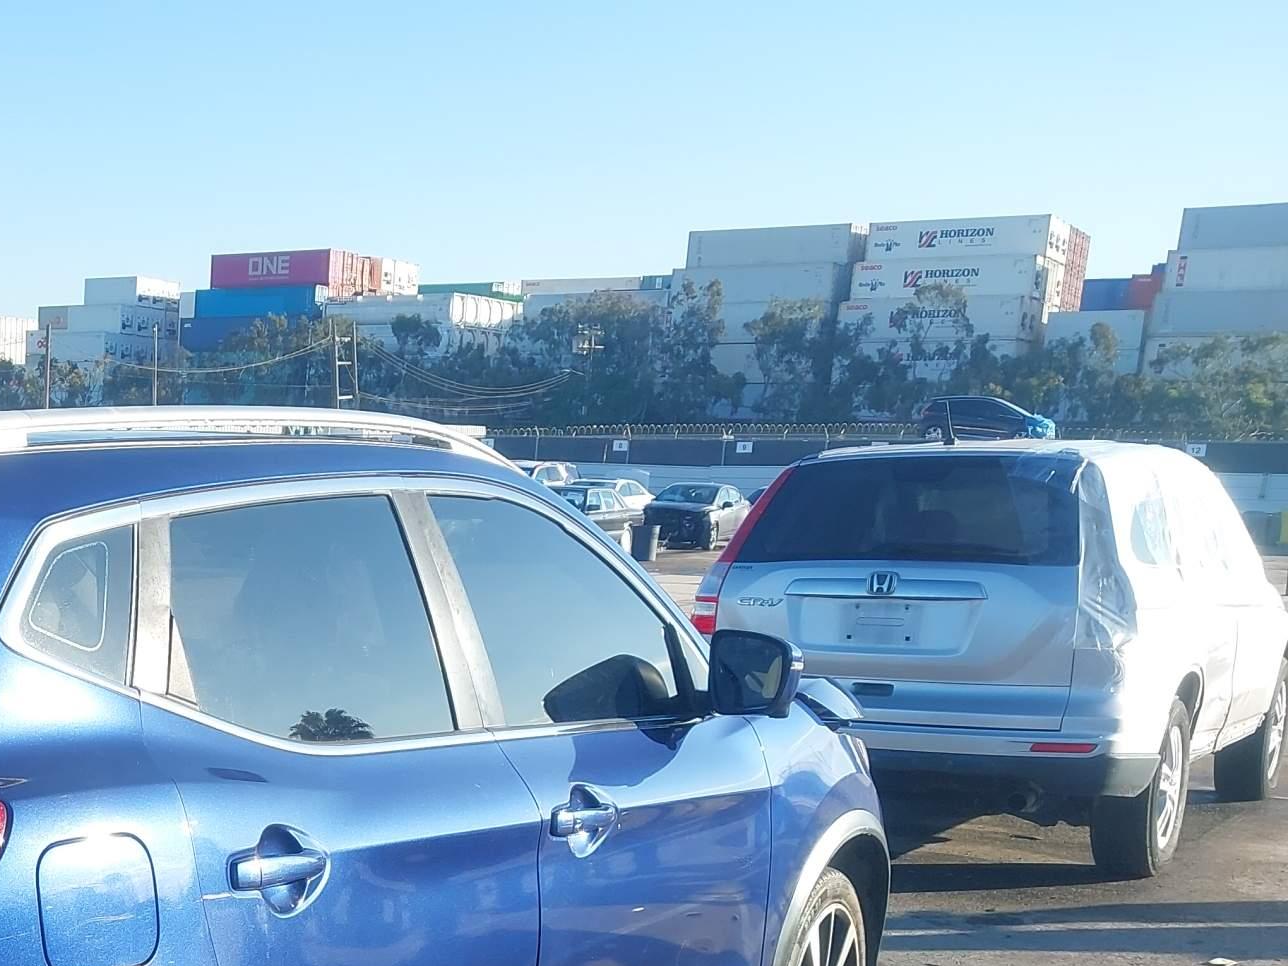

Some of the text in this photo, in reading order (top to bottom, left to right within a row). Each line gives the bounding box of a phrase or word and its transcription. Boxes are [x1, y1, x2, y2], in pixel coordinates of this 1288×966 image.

[940, 228, 995, 239] HORIZON
[248, 255, 290, 276] ONE
[925, 267, 980, 279] HORIZON
[737, 596, 784, 607] CR-V
